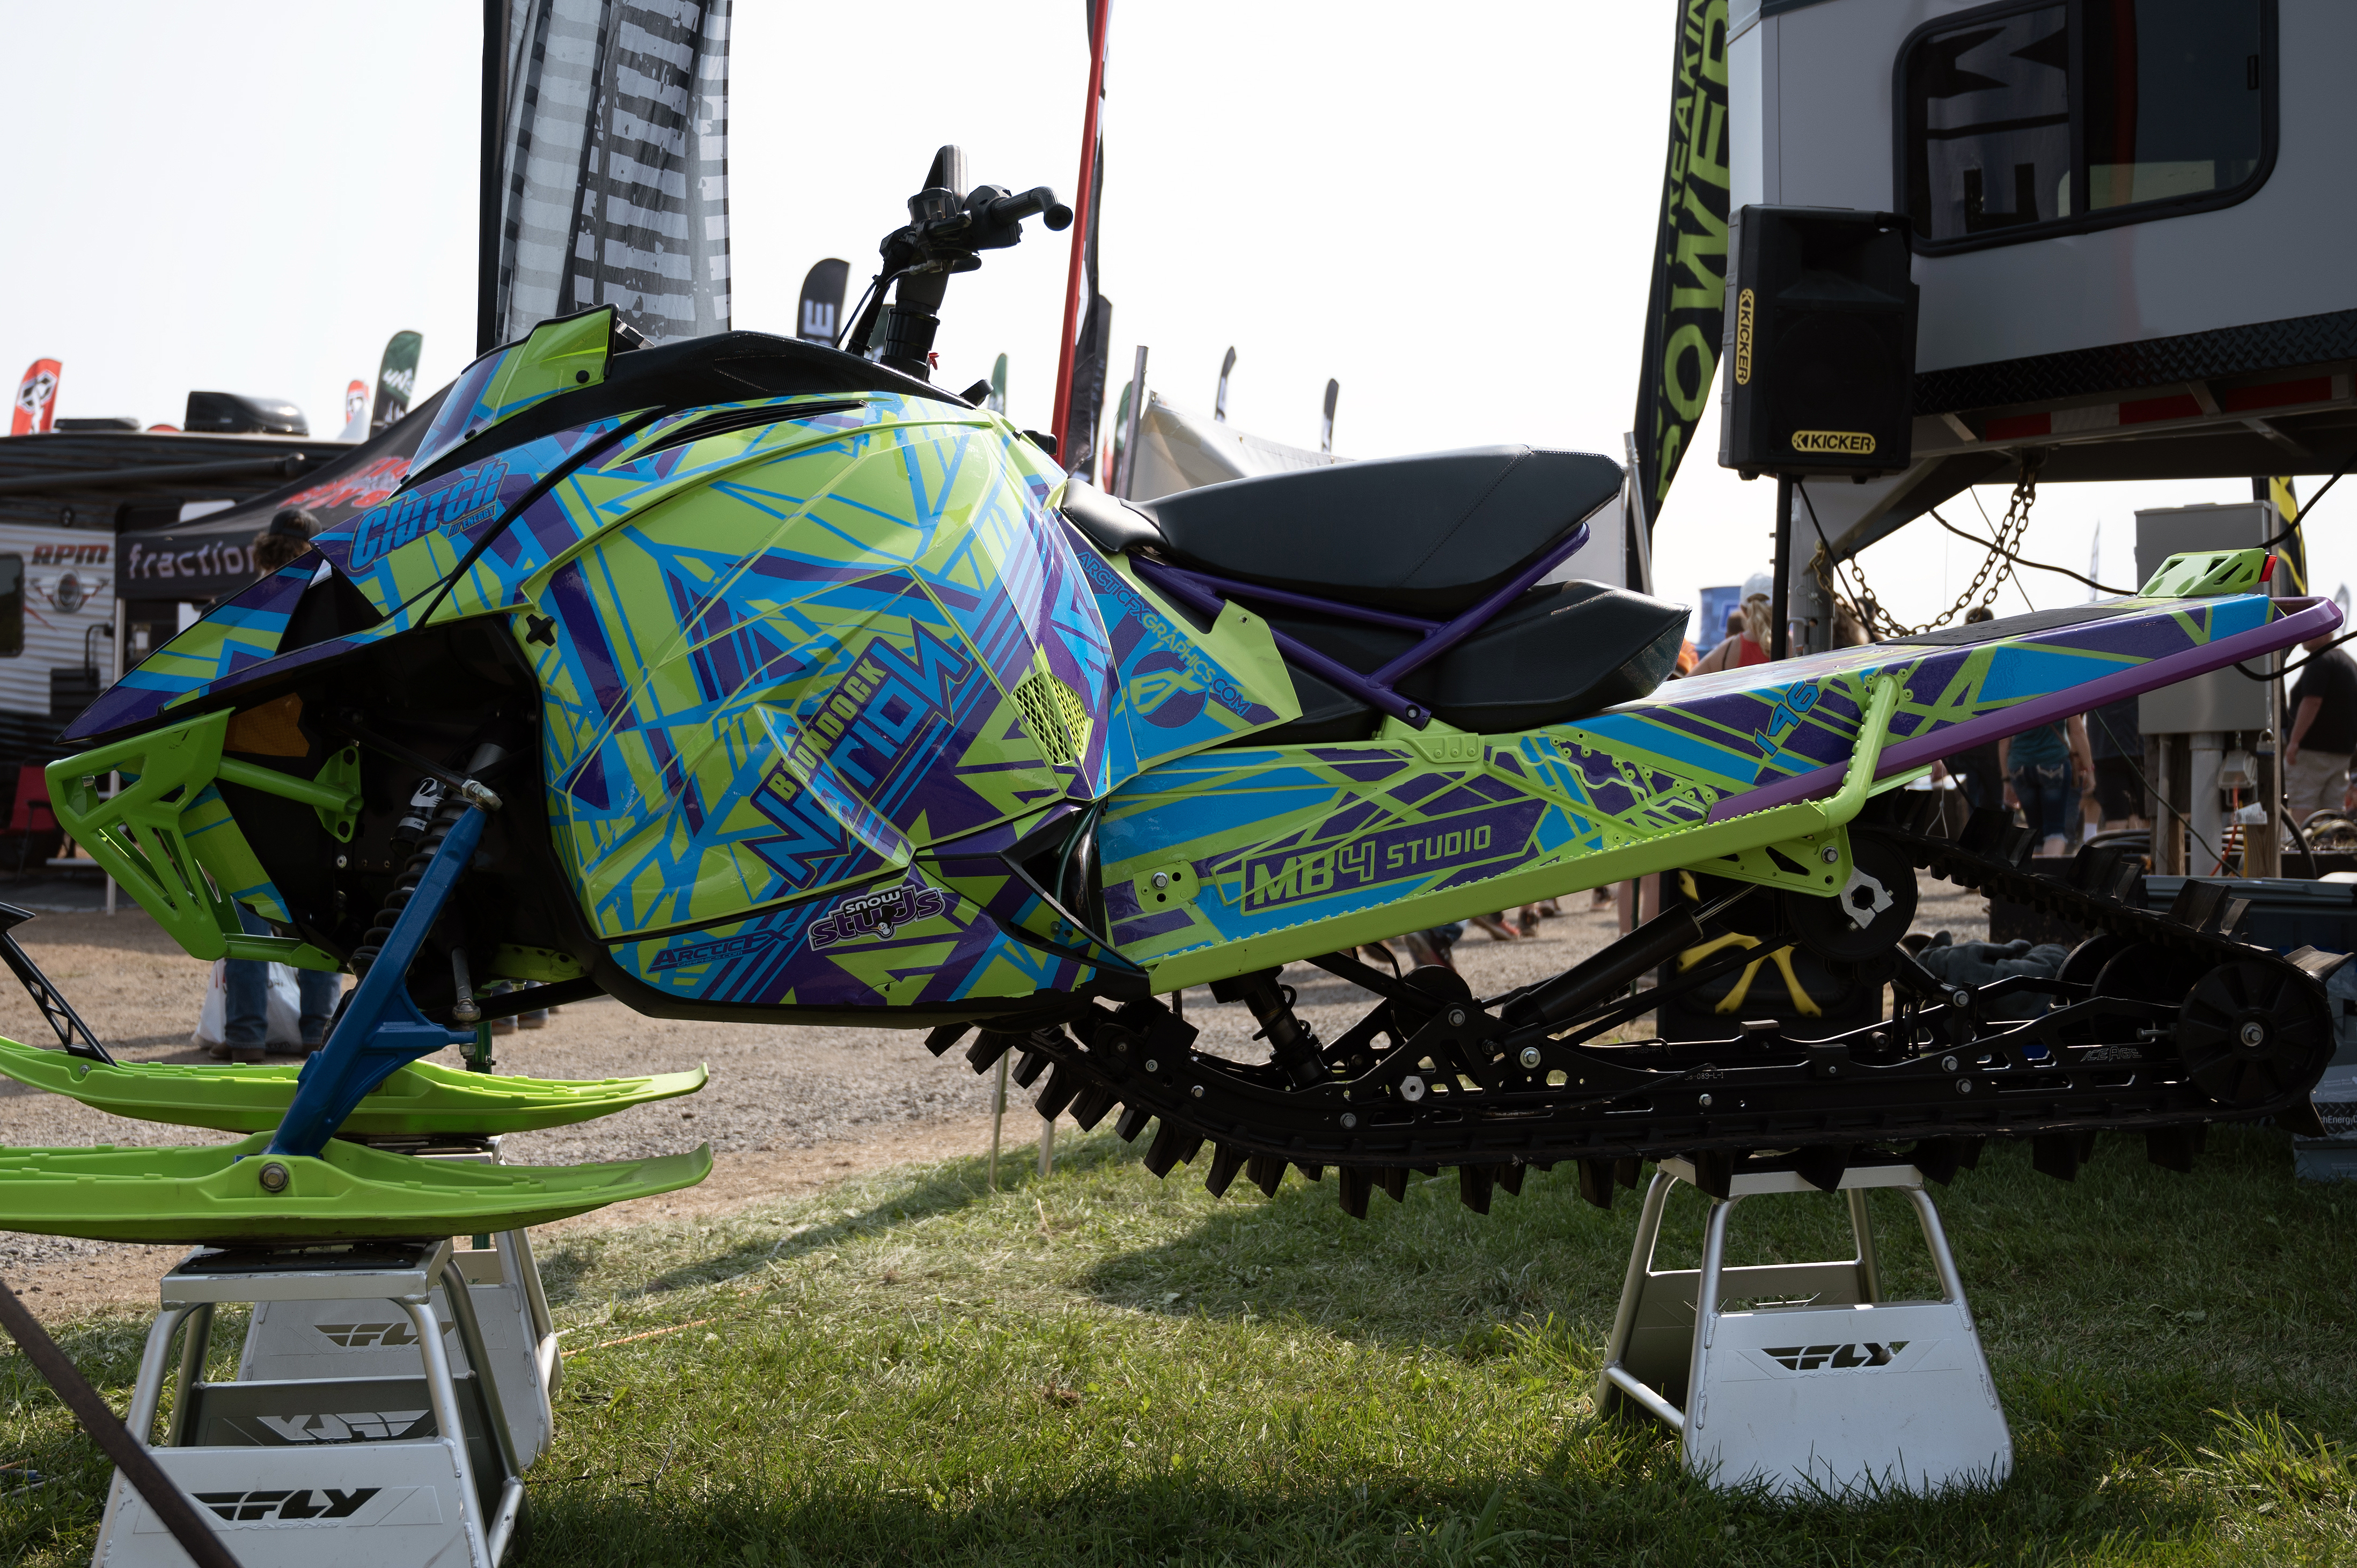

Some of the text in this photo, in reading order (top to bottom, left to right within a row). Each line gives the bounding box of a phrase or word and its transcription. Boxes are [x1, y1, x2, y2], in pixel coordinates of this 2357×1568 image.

[1738, 310, 1751, 380] KICKER
[1810, 435, 1871, 451] KICKER
[462, 505, 495, 528] ENERGY
[32, 544, 109, 564] RPM
[768, 657, 886, 801] BOONDOCK
[1754, 680, 1820, 757] 146
[753, 621, 963, 883] NATION
[1253, 825, 1492, 905] MB4 STUDIO
[845, 889, 901, 914] snow
[1761, 1341, 1910, 1371] FLY
[192, 1487, 383, 1520] FLY
